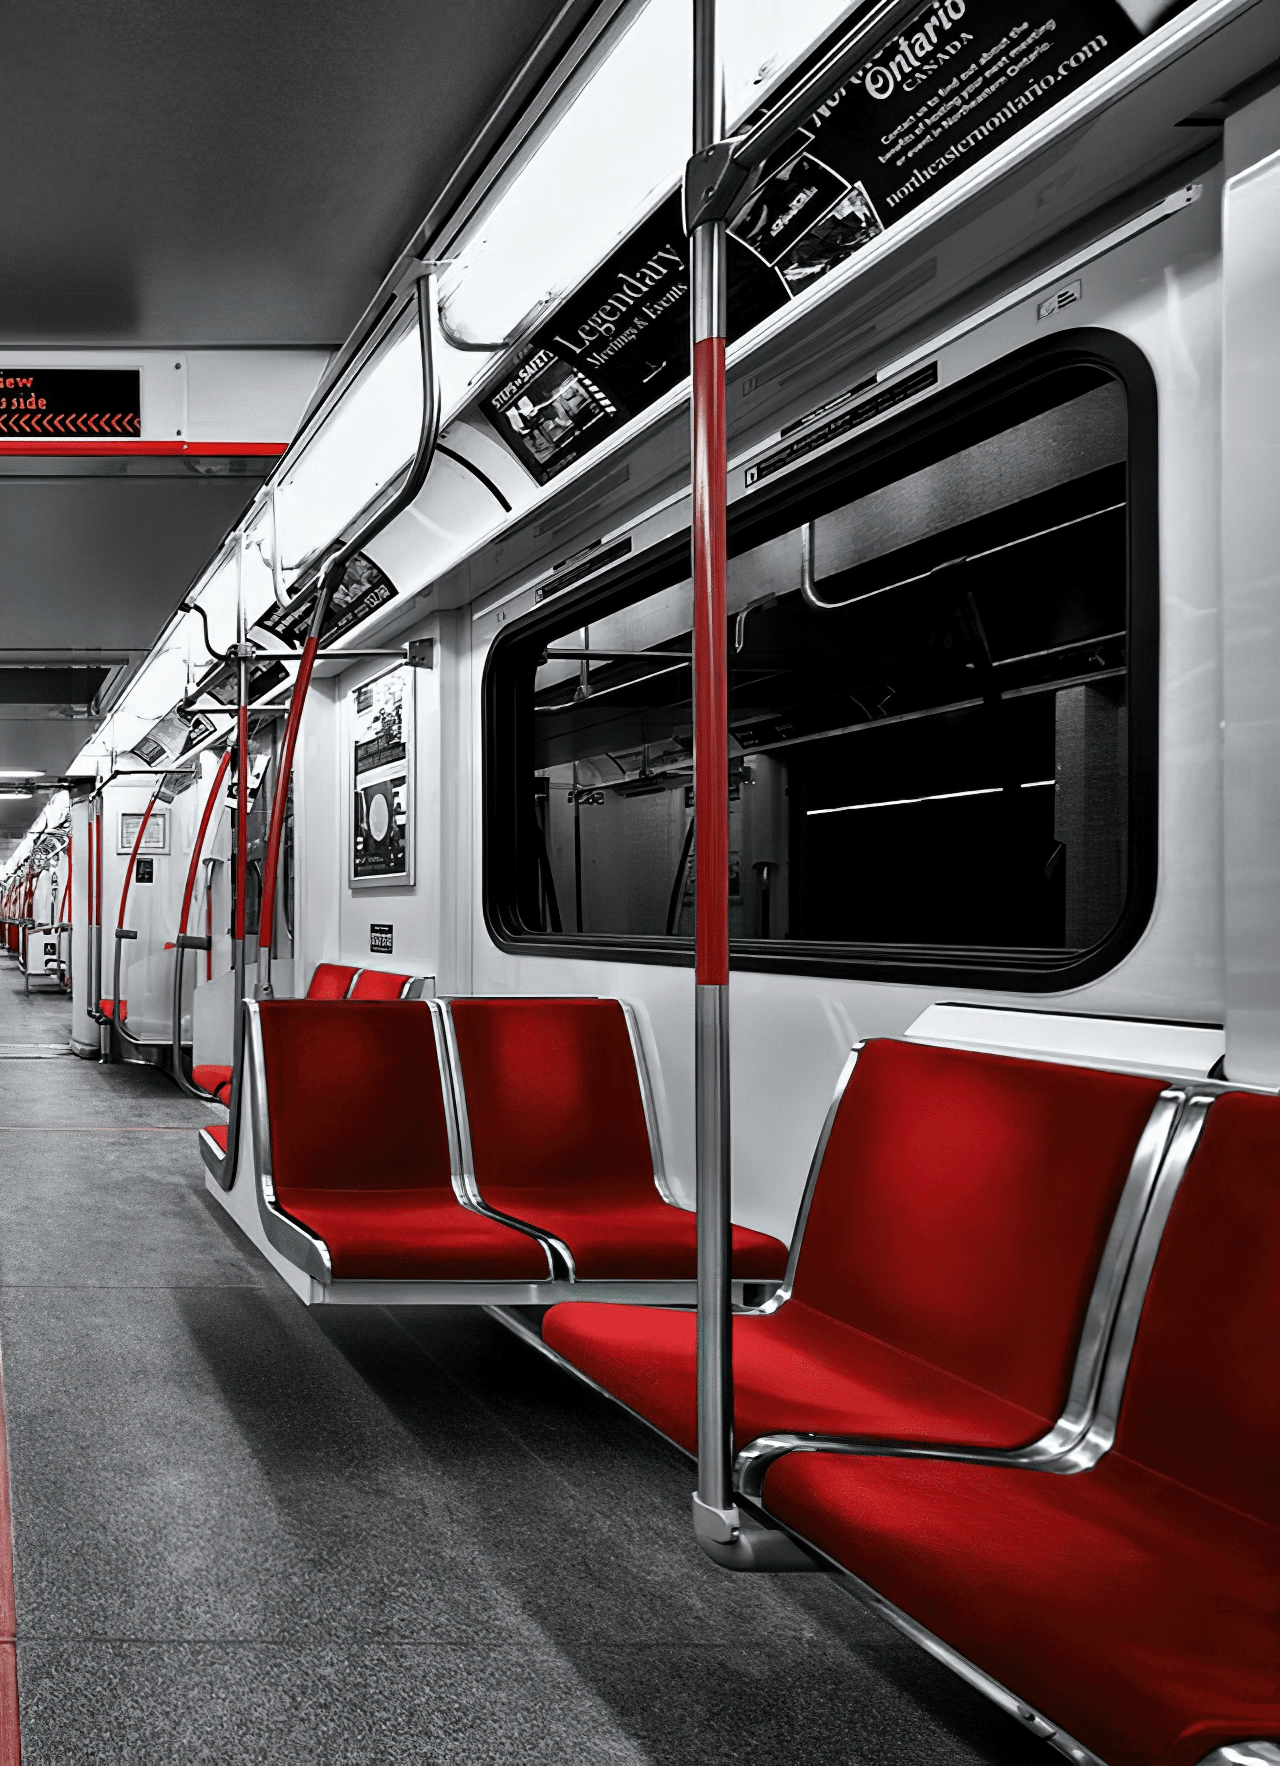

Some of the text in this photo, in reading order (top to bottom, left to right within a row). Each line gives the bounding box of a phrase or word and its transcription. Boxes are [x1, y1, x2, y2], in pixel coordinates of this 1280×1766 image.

[865, 0, 966, 99] Ontario
[903, 32, 974, 92] CANADA
[886, 34, 1109, 207] northeasternontario.com
[553, 243, 685, 354] Legendary
[586, 327, 638, 368] Meetings
[642, 283, 688, 320] Events
[11, 392, 47, 410] side
